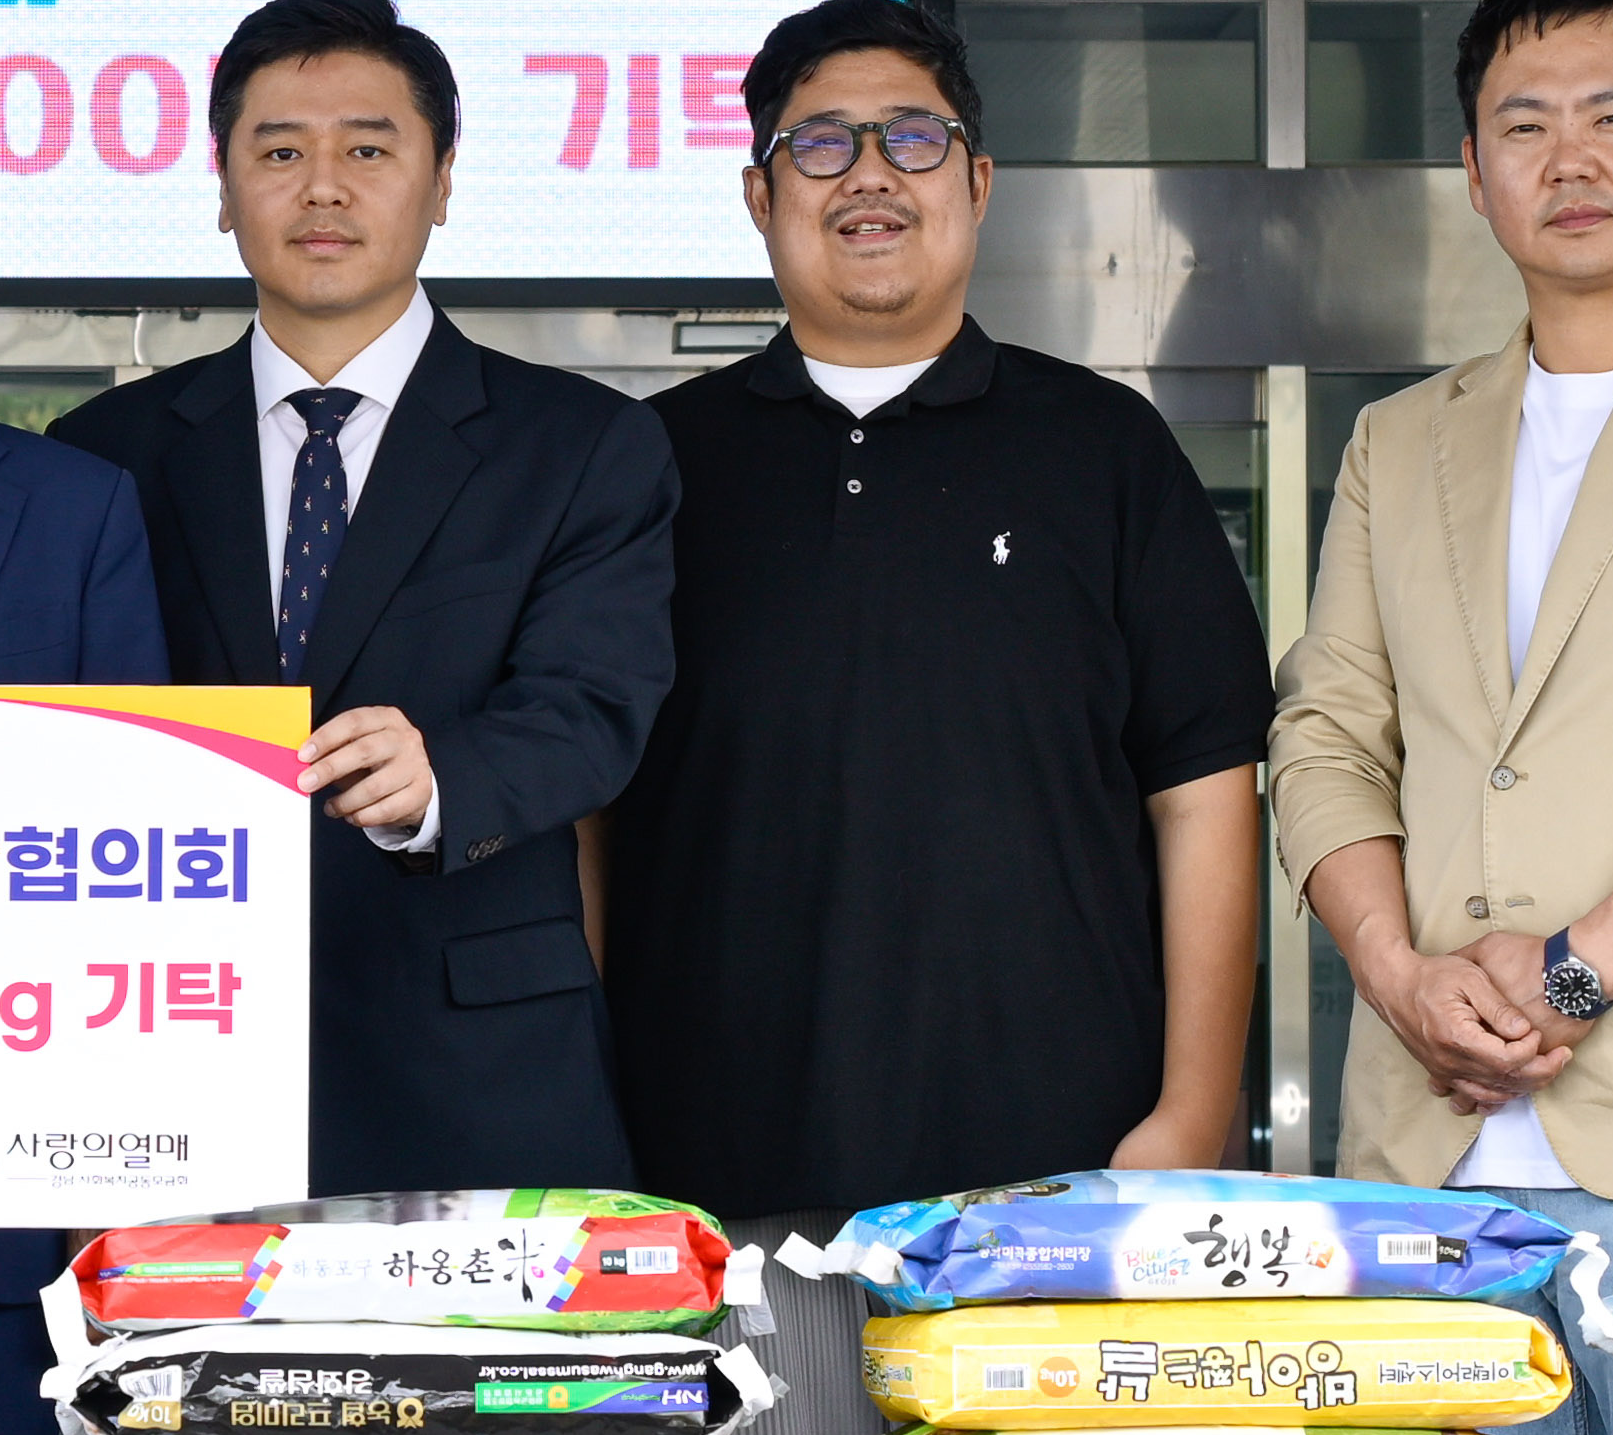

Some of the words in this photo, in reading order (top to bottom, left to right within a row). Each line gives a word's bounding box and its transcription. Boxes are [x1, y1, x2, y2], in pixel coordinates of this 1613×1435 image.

[85, 962, 243, 1035] 기탁
[6, 1131, 190, 1168] 사랑의열매
[258, 1368, 373, 1396] 강화섬쌀
